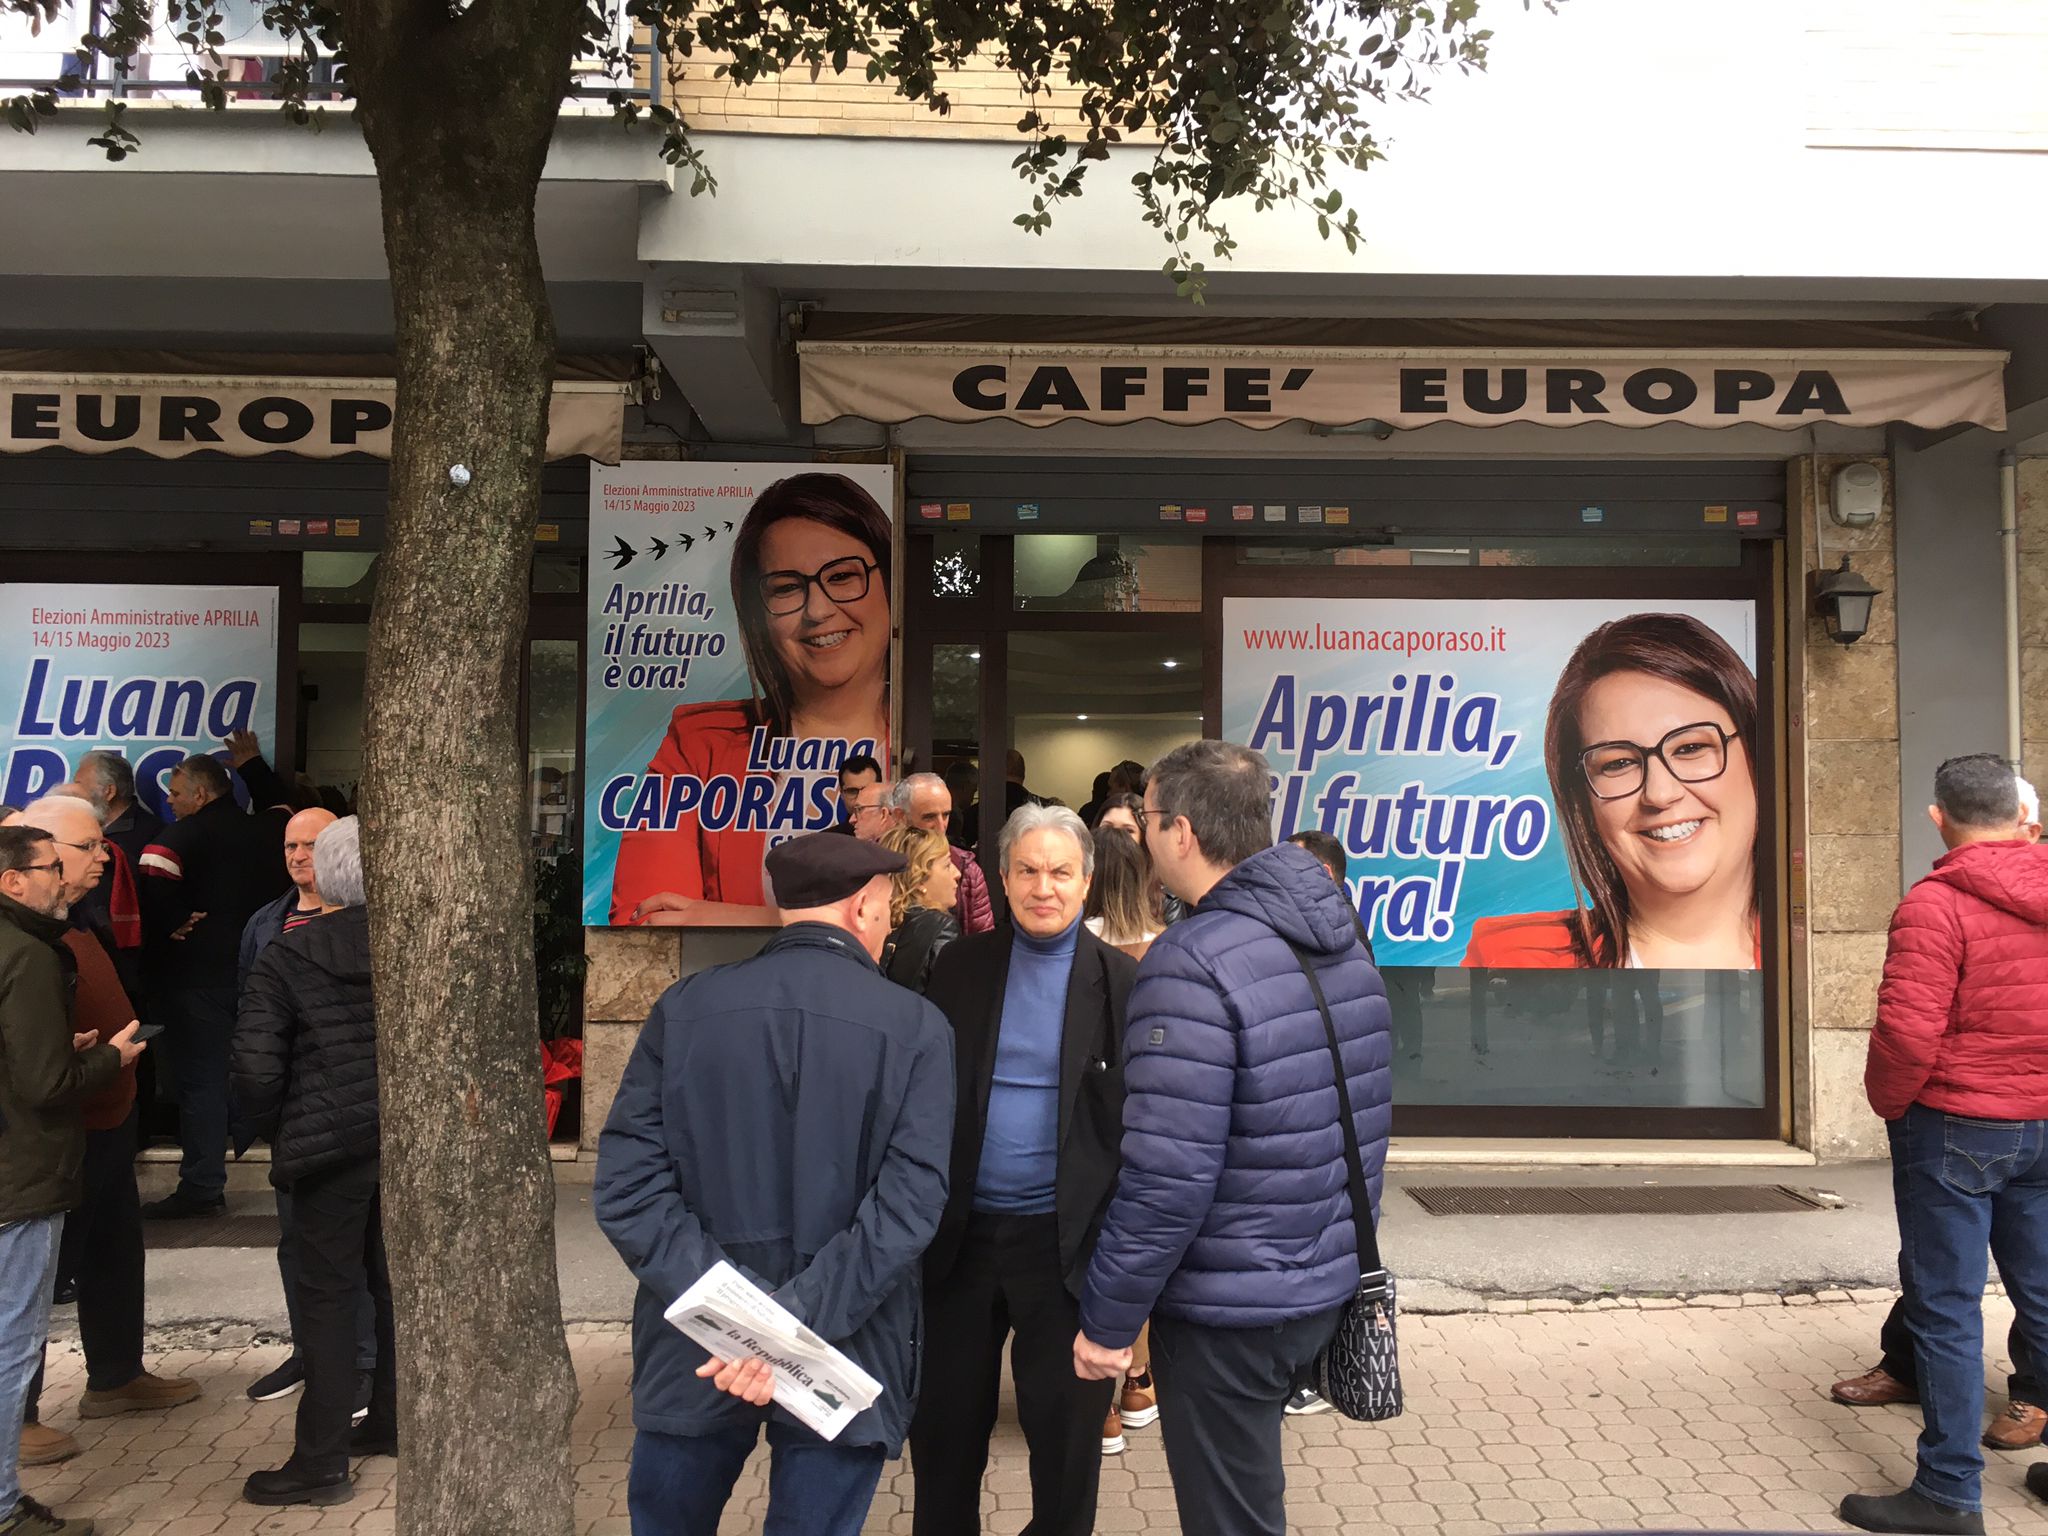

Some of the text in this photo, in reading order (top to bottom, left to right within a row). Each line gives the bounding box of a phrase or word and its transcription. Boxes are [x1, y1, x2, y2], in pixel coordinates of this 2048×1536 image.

[1400, 367, 1852, 415] EUROPA
[603, 484, 754, 498] Elezioni Amministrative APRILIA
[604, 499, 696, 515] 14/15 Maggio 2023
[31, 607, 260, 628] Elezioni Amministrative APRILIA
[602, 583, 715, 622] Aprilia,
[32, 631, 170, 652] 14/15 Maggio 2023
[603, 624, 726, 657] il futuro
[1243, 623, 1506, 657] www.luanacaporaso.it
[604, 657, 690, 689] è ora!
[16, 656, 259, 739] Luana
[1249, 672, 1518, 772] Aprilia,
[747, 726, 876, 771] Luana
[599, 774, 846, 832] CAPORAS
[1314, 774, 1549, 858] futuro
[1344, 860, 1462, 938] ra!
[726, 1329, 742, 1341] la
[741, 1338, 814, 1387] Repubblica
